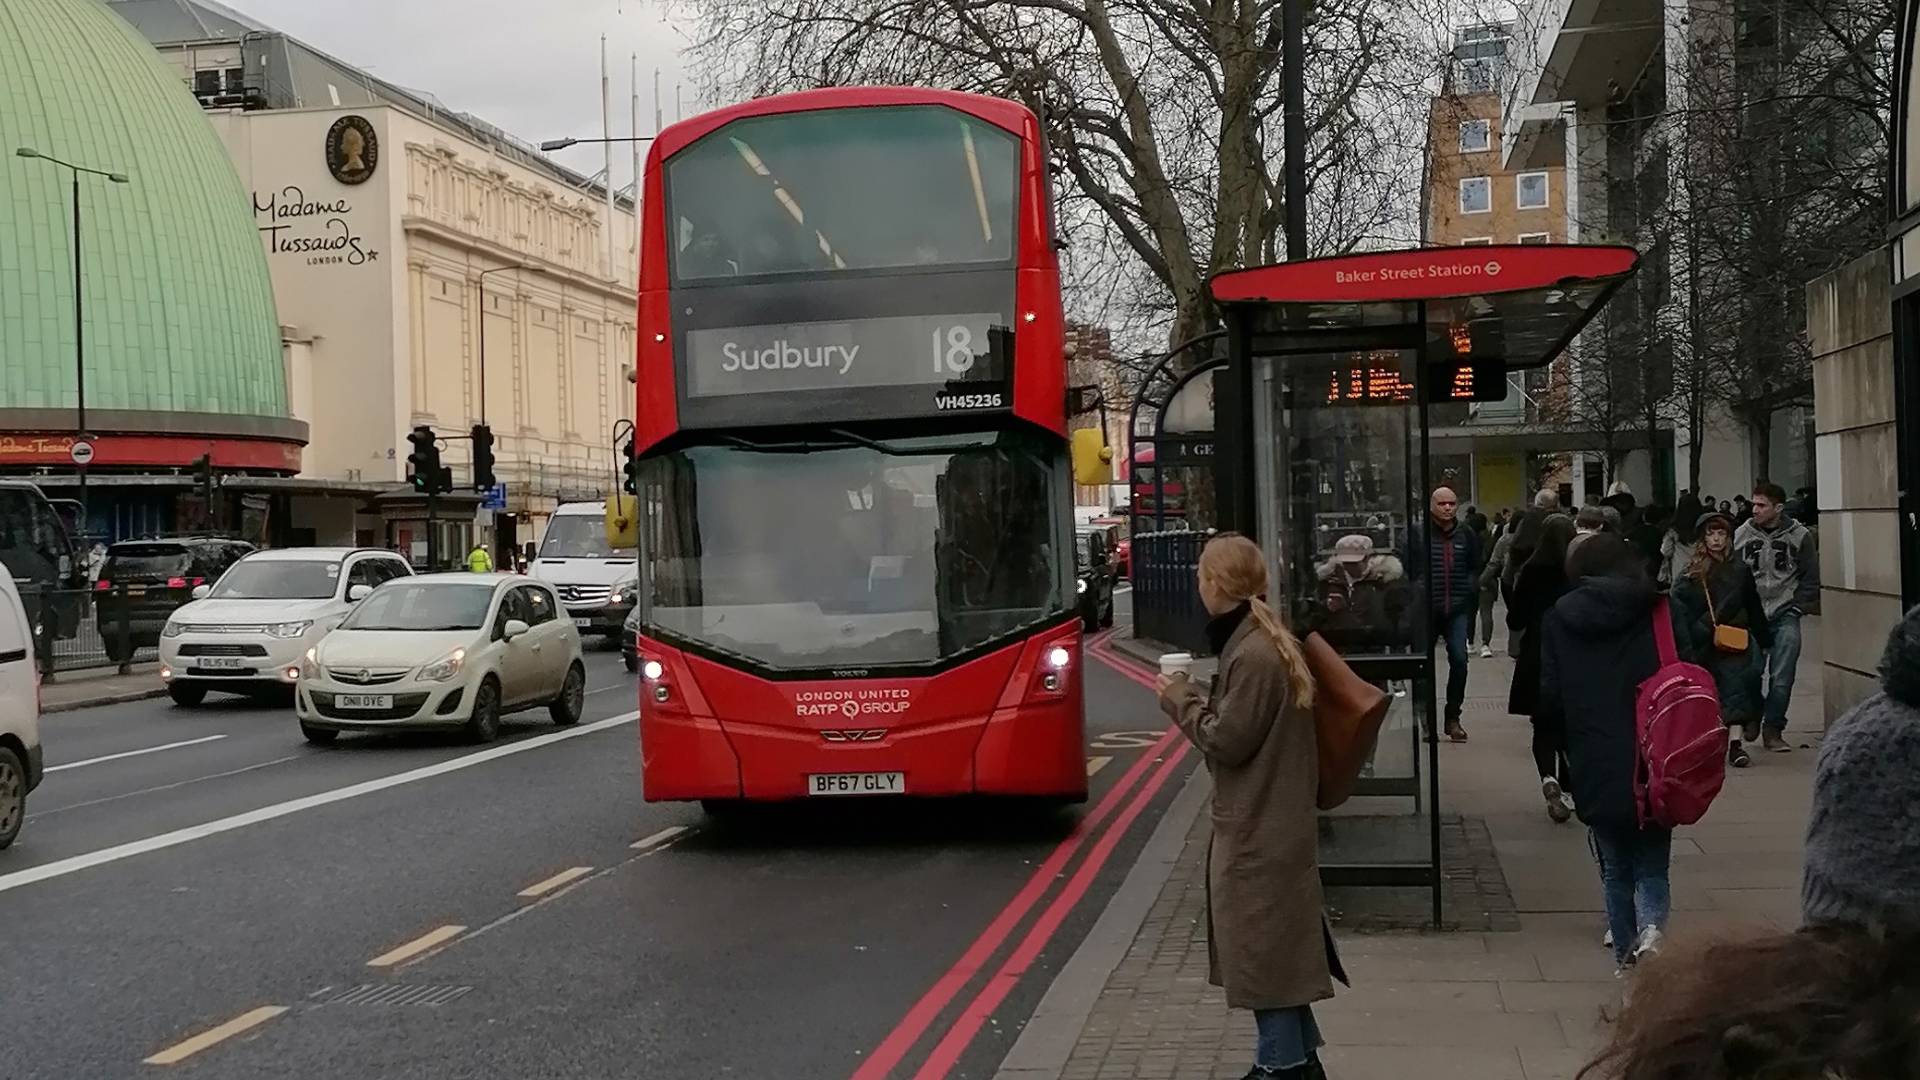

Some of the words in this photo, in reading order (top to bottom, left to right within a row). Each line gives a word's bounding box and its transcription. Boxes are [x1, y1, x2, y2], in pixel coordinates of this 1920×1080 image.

[253, 186, 352, 222] Madame
[258, 218, 366, 265] Tussauds
[307, 256, 343, 265] LONDON
[1336, 270, 1376, 284] Baker
[1380, 267, 1425, 281] Street
[1428, 264, 1482, 278] Station
[721, 339, 859, 375] Sudbury
[932, 325, 975, 373] 18
[935, 393, 1001, 410] VH45236
[796, 691, 853, 702] LONDON
[859, 689, 910, 700] UNITED
[796, 703, 838, 716] RATP
[861, 701, 911, 714] GROUP
[816, 775, 860, 791] BF67
[864, 774, 897, 790] GLY
